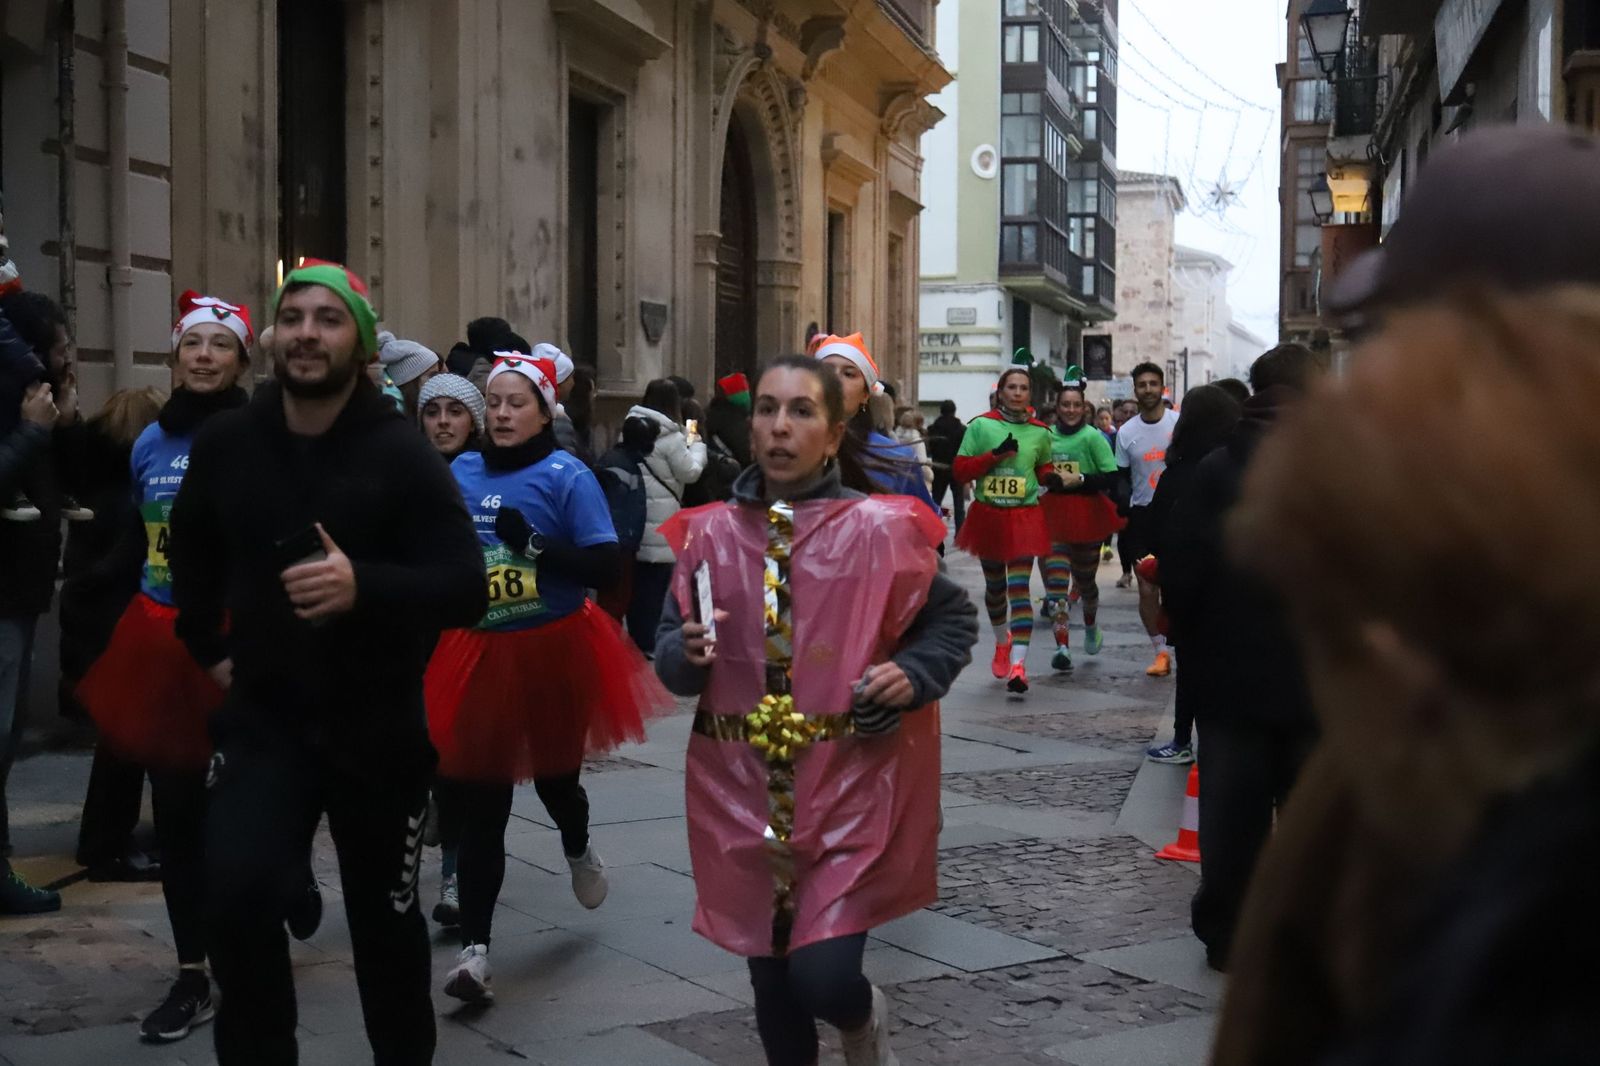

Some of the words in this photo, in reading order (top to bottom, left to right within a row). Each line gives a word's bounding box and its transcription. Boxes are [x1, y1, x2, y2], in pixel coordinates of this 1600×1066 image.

[170, 454, 190, 470] 46
[987, 477, 1018, 495] 418
[480, 494, 502, 509] 46
[485, 568, 524, 601] 58
